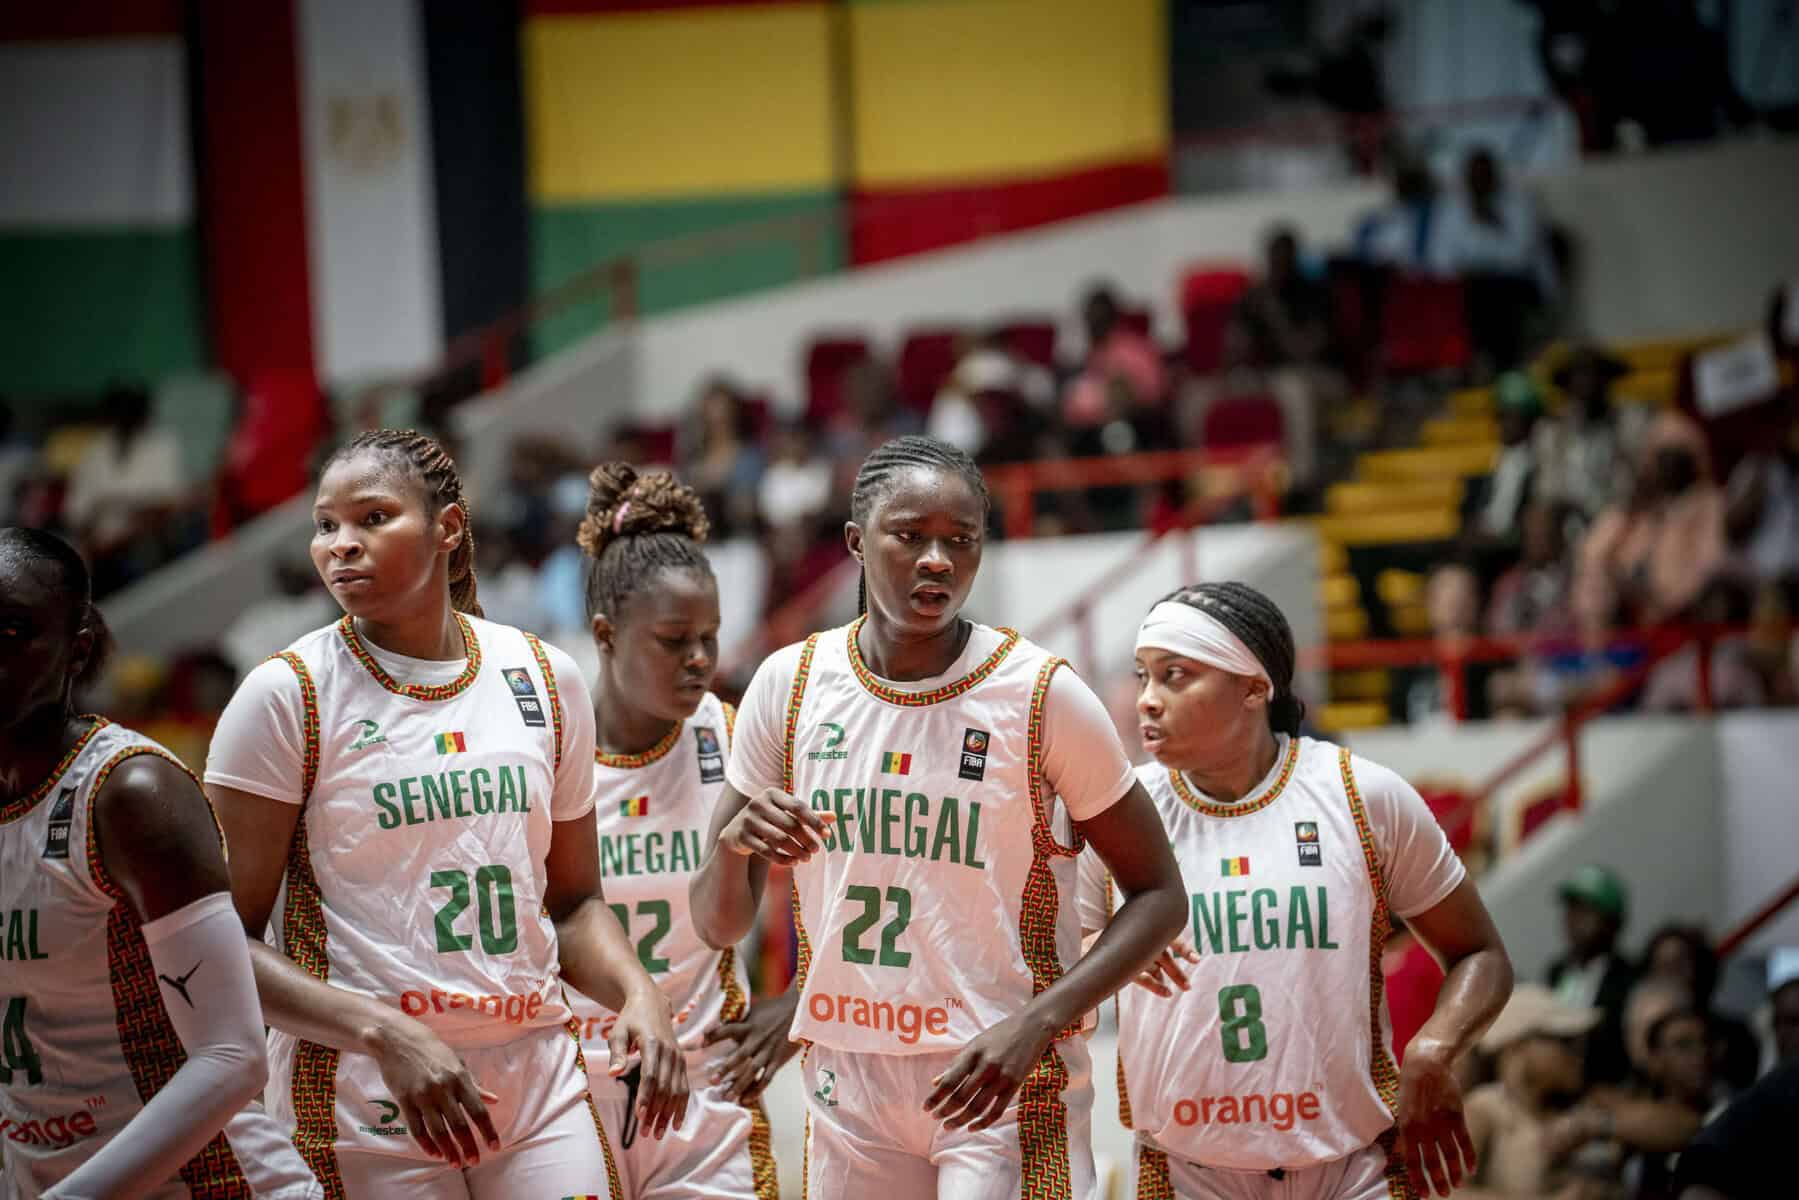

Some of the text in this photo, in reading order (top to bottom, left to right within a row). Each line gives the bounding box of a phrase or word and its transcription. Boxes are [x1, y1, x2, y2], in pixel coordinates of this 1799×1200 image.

[373, 765, 531, 830] SENEGAL
[811, 787, 985, 869] SENEGAL
[430, 864, 518, 955] 20
[842, 885, 912, 968] 22
[1192, 885, 1339, 955] NEGAL
[0, 997, 43, 1085] 4
[1218, 983, 1268, 1063] 8
